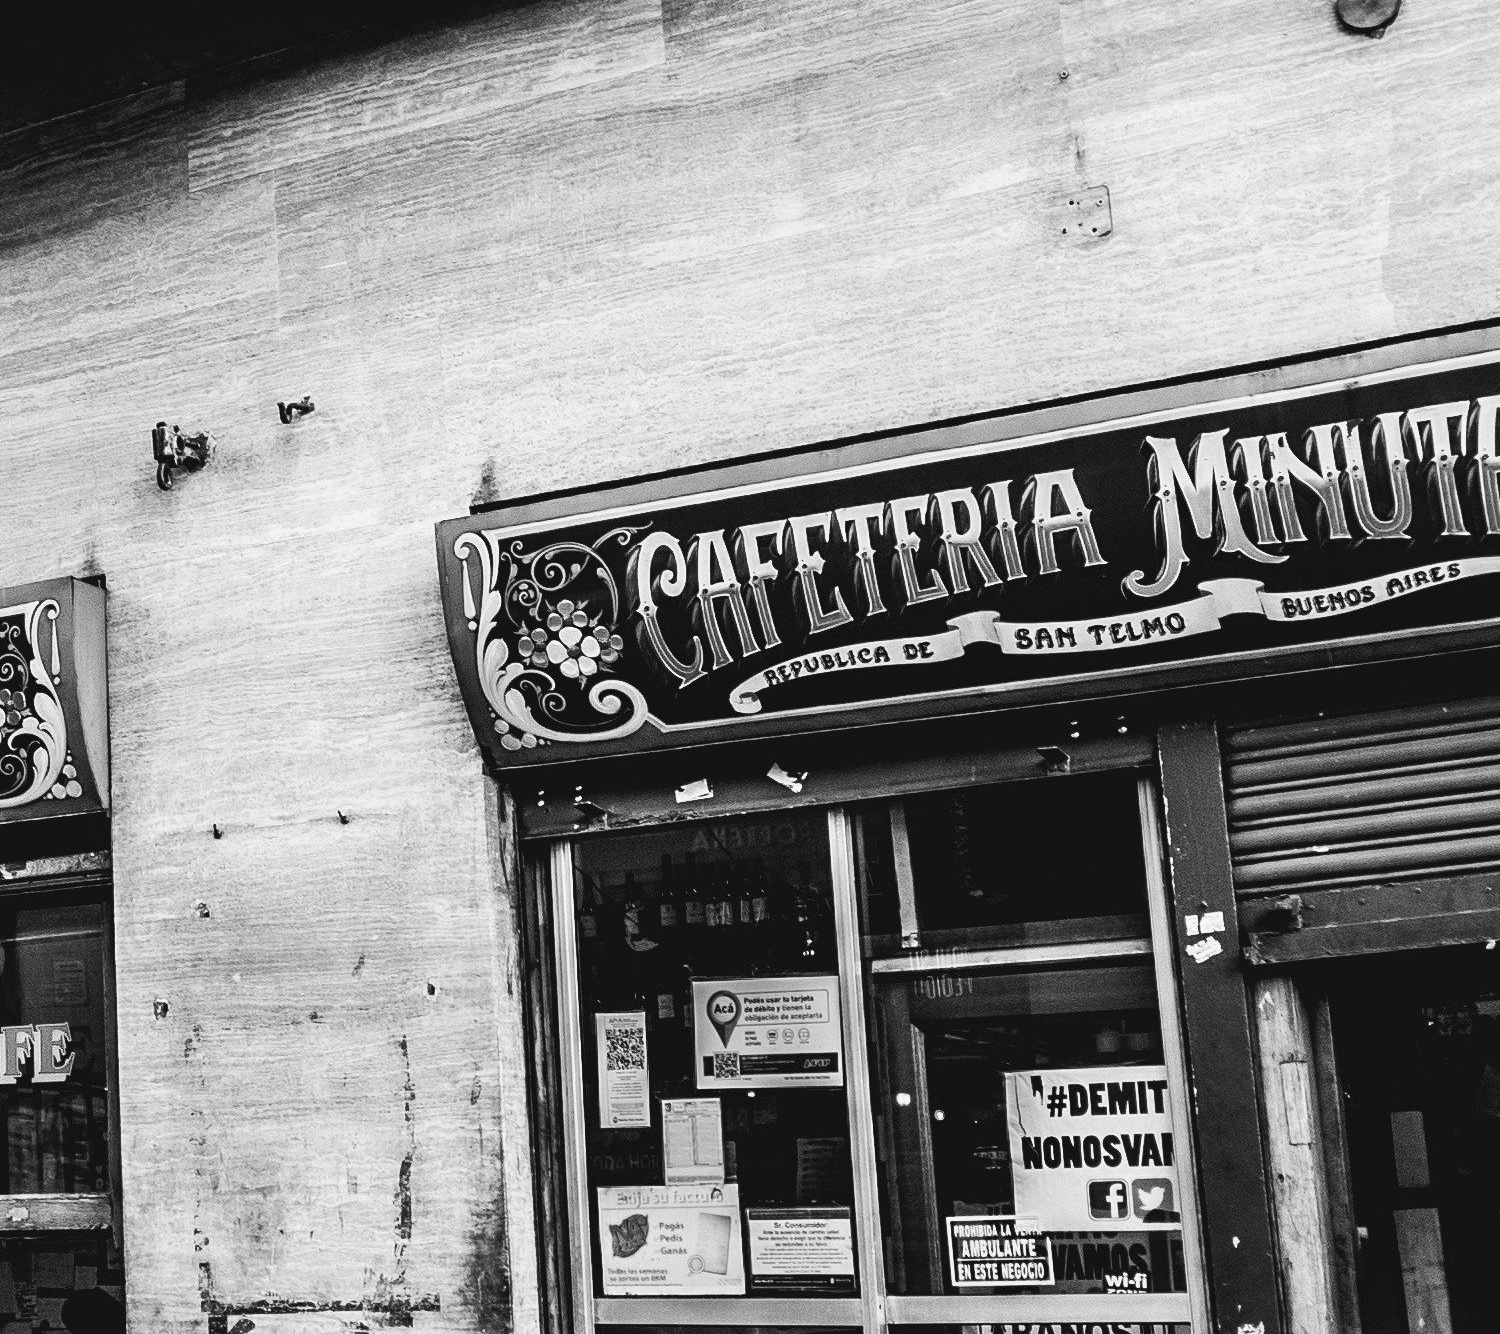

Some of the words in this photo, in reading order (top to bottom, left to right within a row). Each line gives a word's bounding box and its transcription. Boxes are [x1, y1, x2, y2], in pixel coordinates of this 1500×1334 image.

[632, 468, 1108, 688] CAFETERIA
[763, 644, 889, 687] REPUBLICA
[902, 639, 935, 661] DE
[1014, 623, 1078, 650] SAN
[1093, 612, 1187, 646] TELMO
[1281, 584, 1376, 619] BUENOS
[1385, 561, 1462, 597] AIRES
[713, 1002, 735, 1014] Acá
[953, 1224, 998, 1239] PROHIBIDA
[1000, 1223, 1012, 1238] LA
[961, 1239, 1037, 1258] AMBULANTE
[957, 1263, 972, 1281] EN
[973, 1262, 999, 1280] ESTE
[1001, 1262, 1045, 1280] NEGOCIO
[1104, 1273, 1148, 1289] wi-fi
